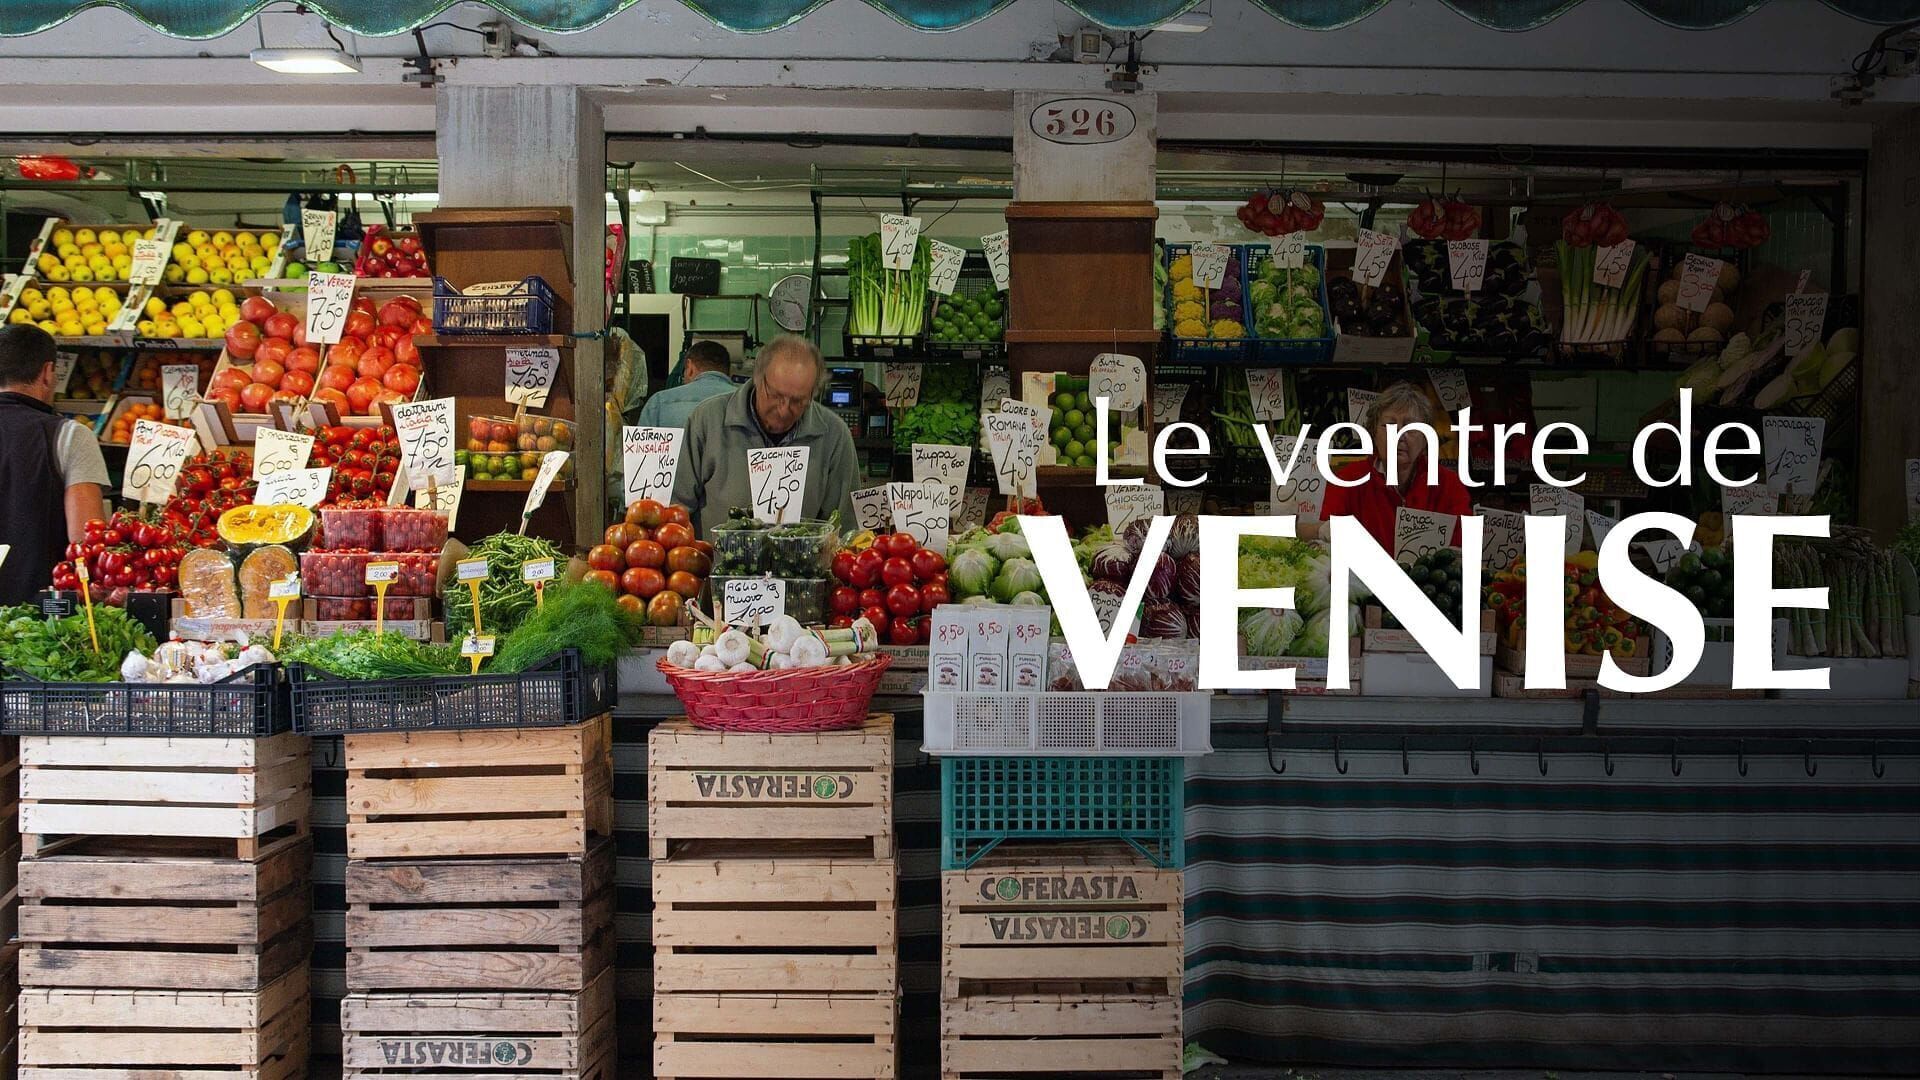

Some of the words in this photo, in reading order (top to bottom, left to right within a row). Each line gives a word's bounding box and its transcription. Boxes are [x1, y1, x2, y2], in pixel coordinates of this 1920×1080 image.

[1046, 108, 1116, 136] 326
[881, 213, 910, 225] CICORIA
[987, 415, 1027, 433] ROMANA
[625, 428, 674, 443] NOSTRANO
[751, 450, 801, 466] ZUCCHINE
[891, 485, 932, 501] NAPOLI
[1106, 493, 1154, 506] CHIOGGIA
[698, 773, 853, 801] COFERASTA
[978, 874, 1139, 902] COFERASTA
[987, 914, 1147, 942] COFERASTA
[380, 1040, 532, 1068] COFERASTA
